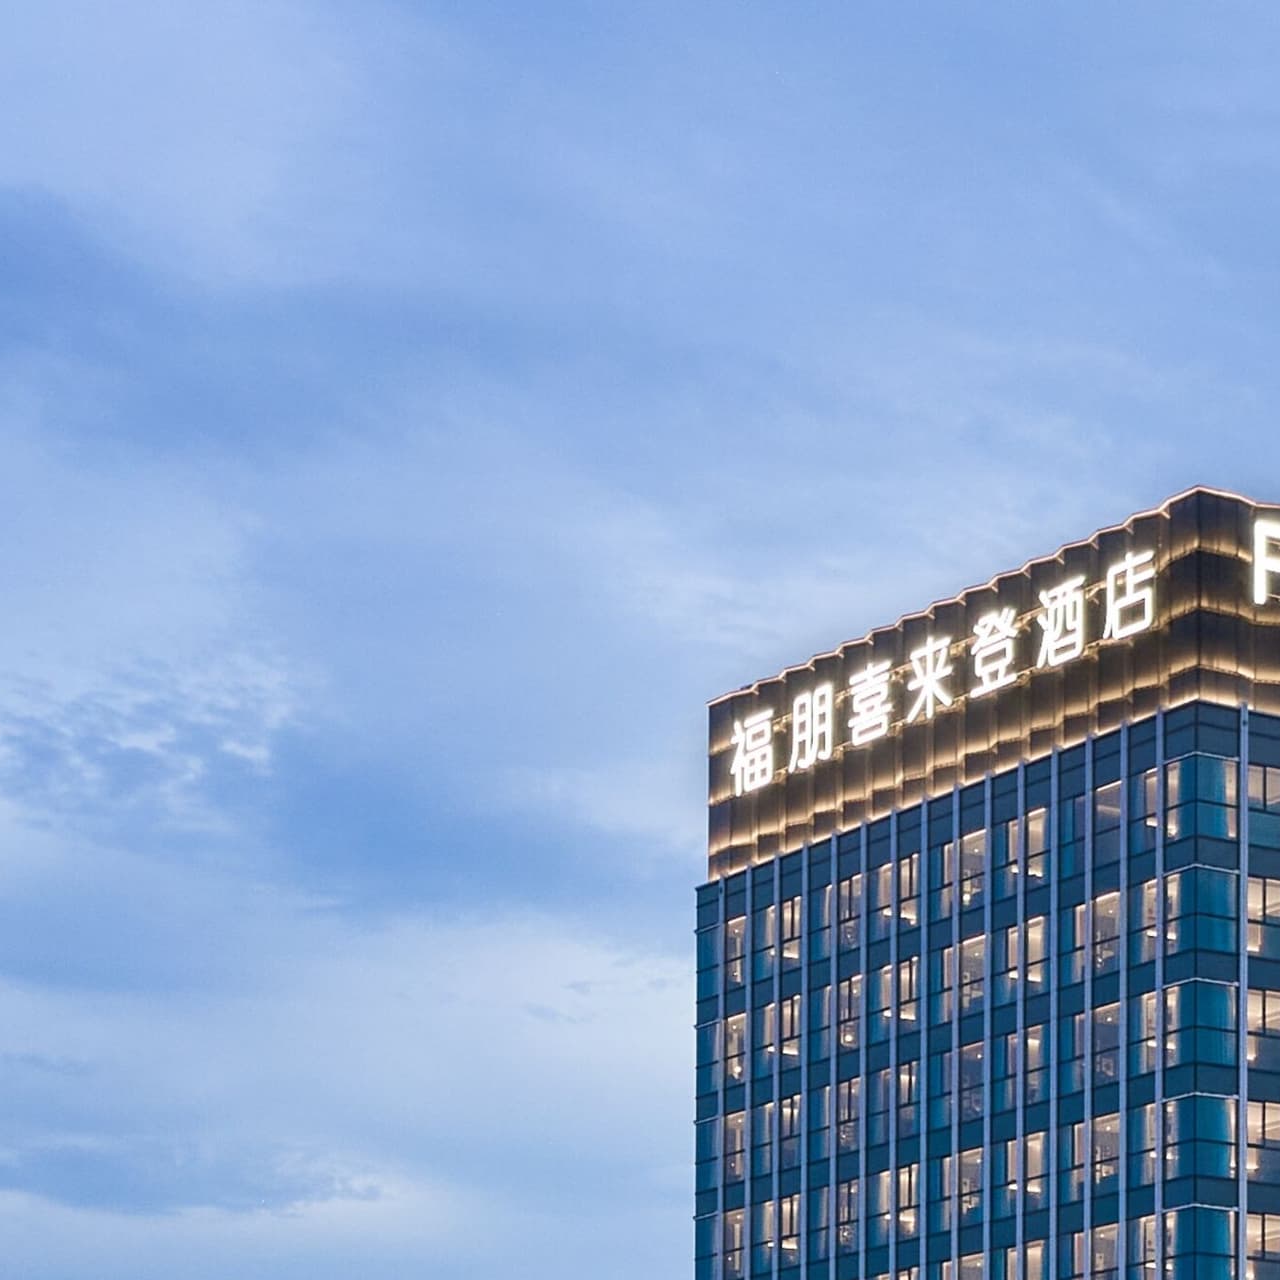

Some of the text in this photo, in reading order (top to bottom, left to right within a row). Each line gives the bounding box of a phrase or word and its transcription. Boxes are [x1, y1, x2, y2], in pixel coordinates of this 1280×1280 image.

[729, 549, 1157, 797] 福朋喜来登酒店
